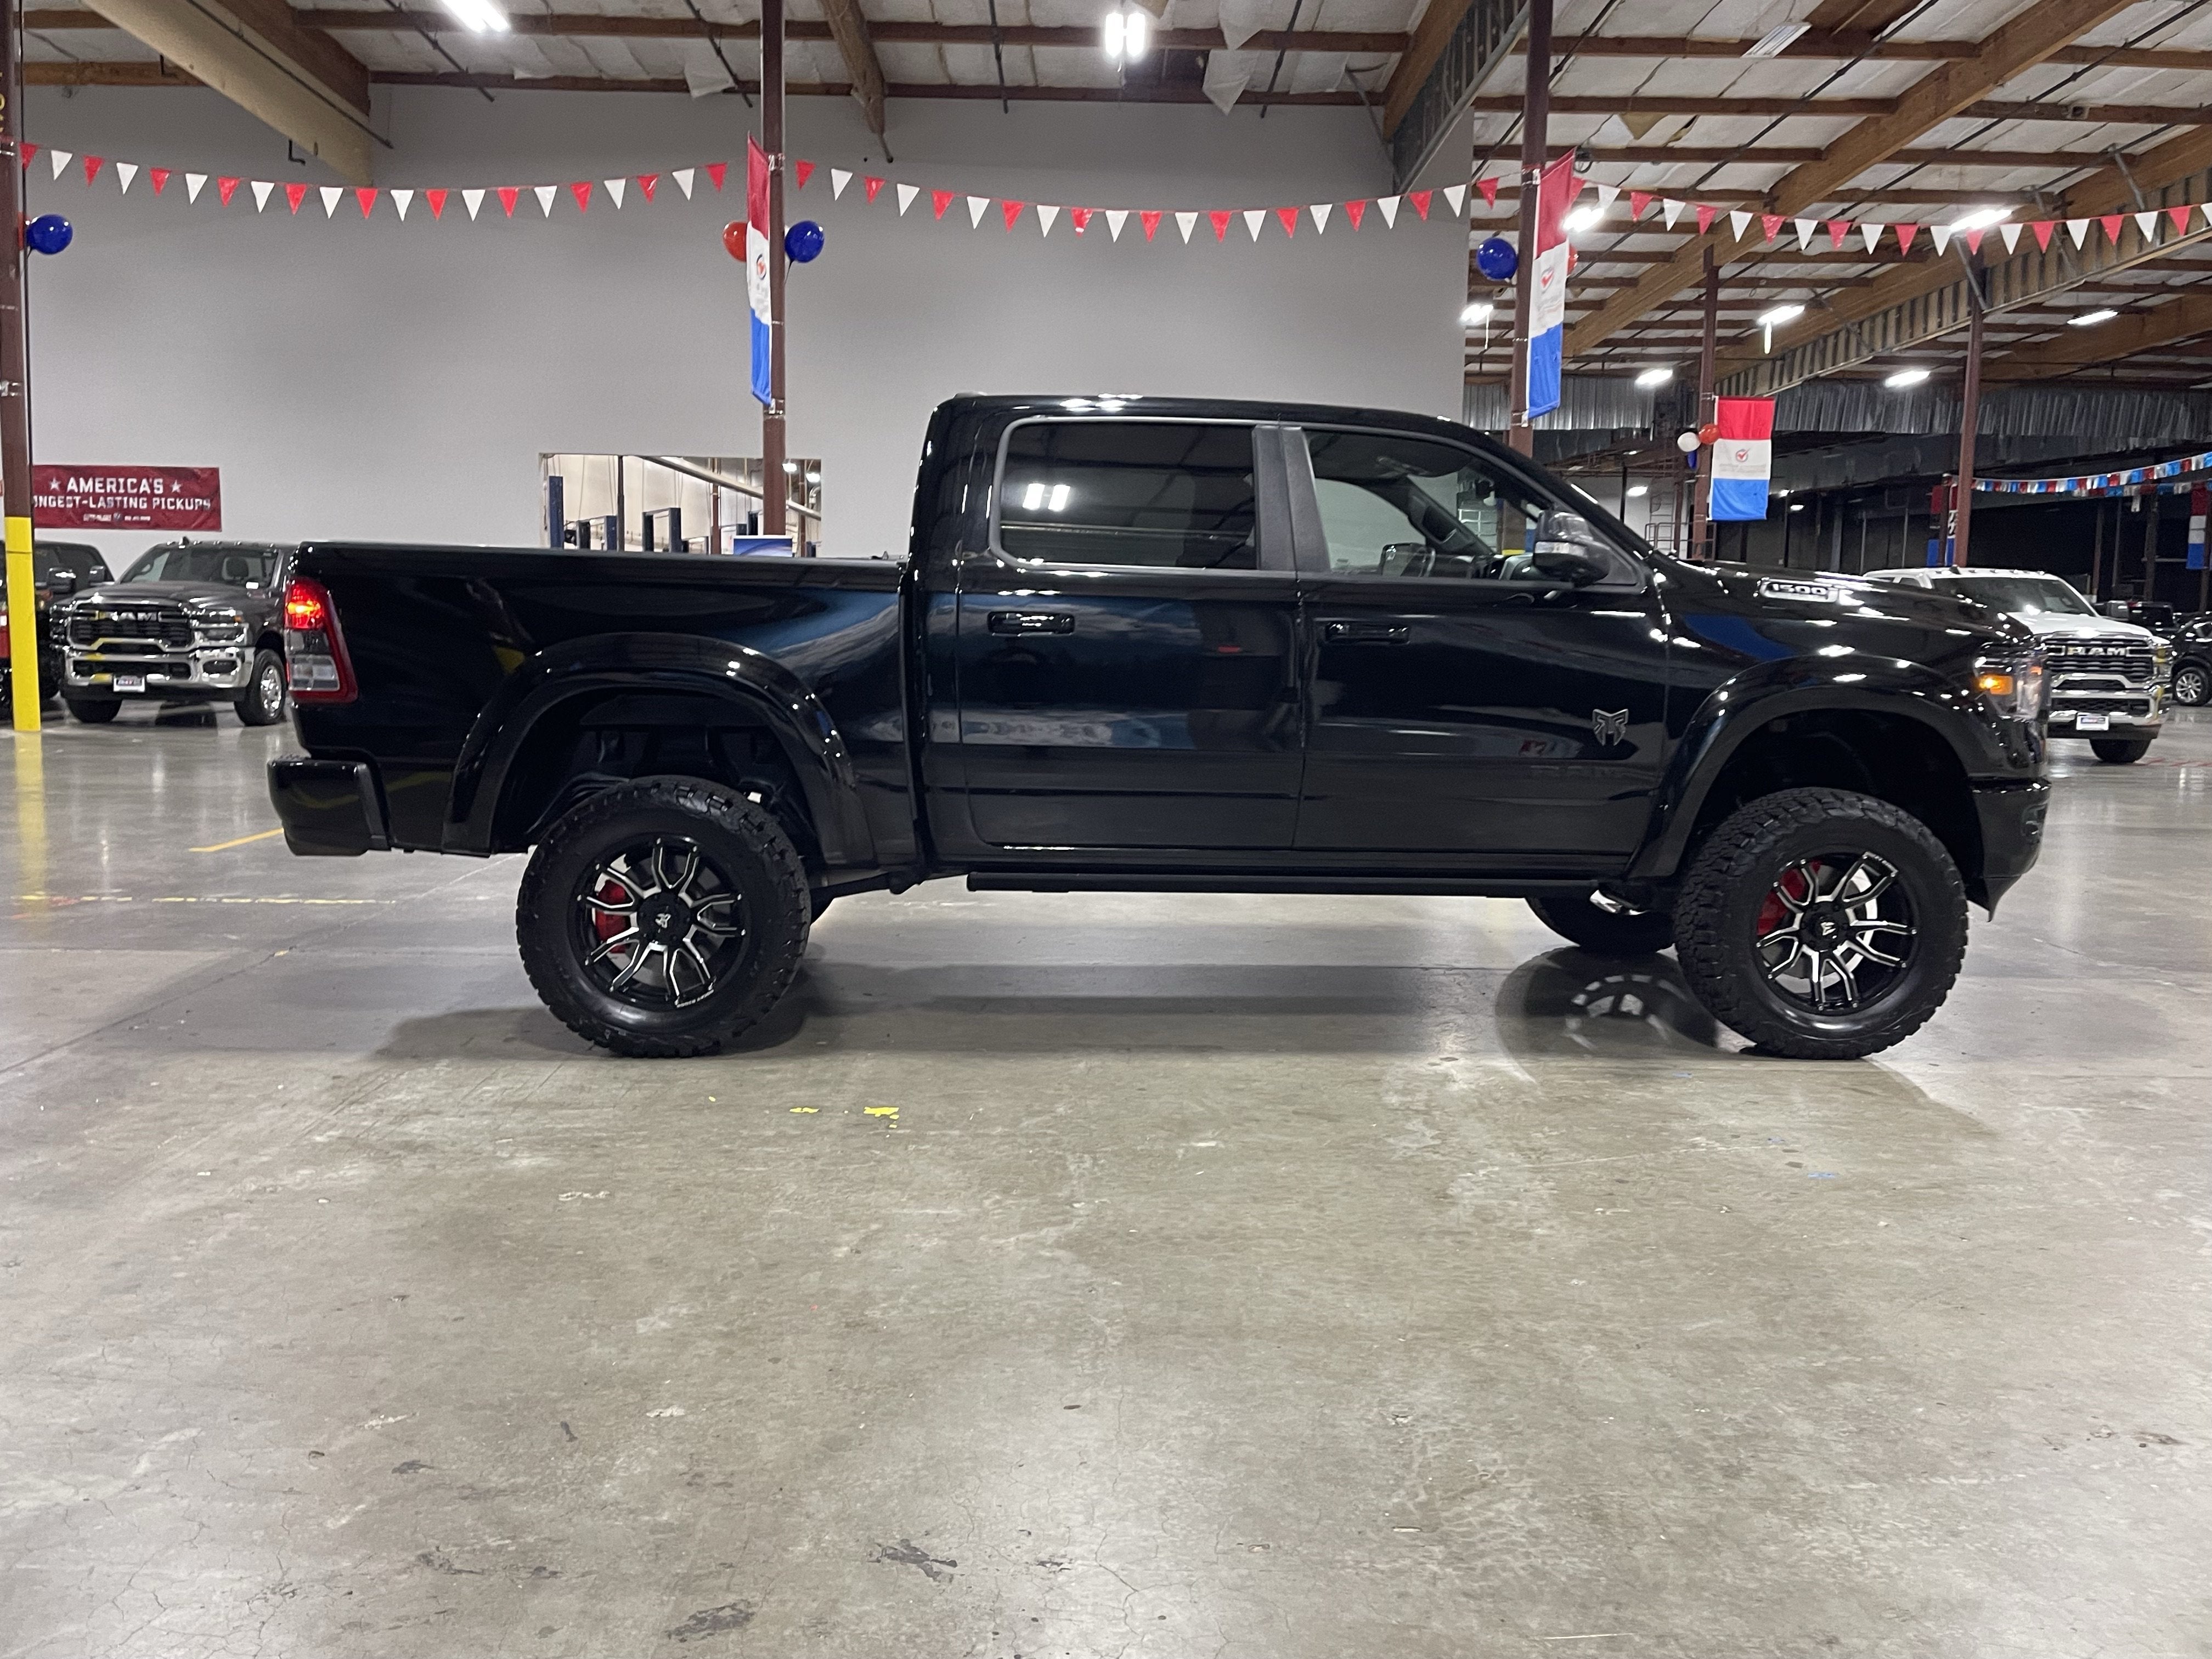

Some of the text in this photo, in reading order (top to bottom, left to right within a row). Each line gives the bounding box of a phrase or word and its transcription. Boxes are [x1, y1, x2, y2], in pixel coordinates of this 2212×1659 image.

[66, 477, 163, 494] AMERICA'S
[153, 497, 211, 510] PICKUPS
[1773, 583, 1827, 595] 1500
[2067, 646, 2126, 656] RAM
